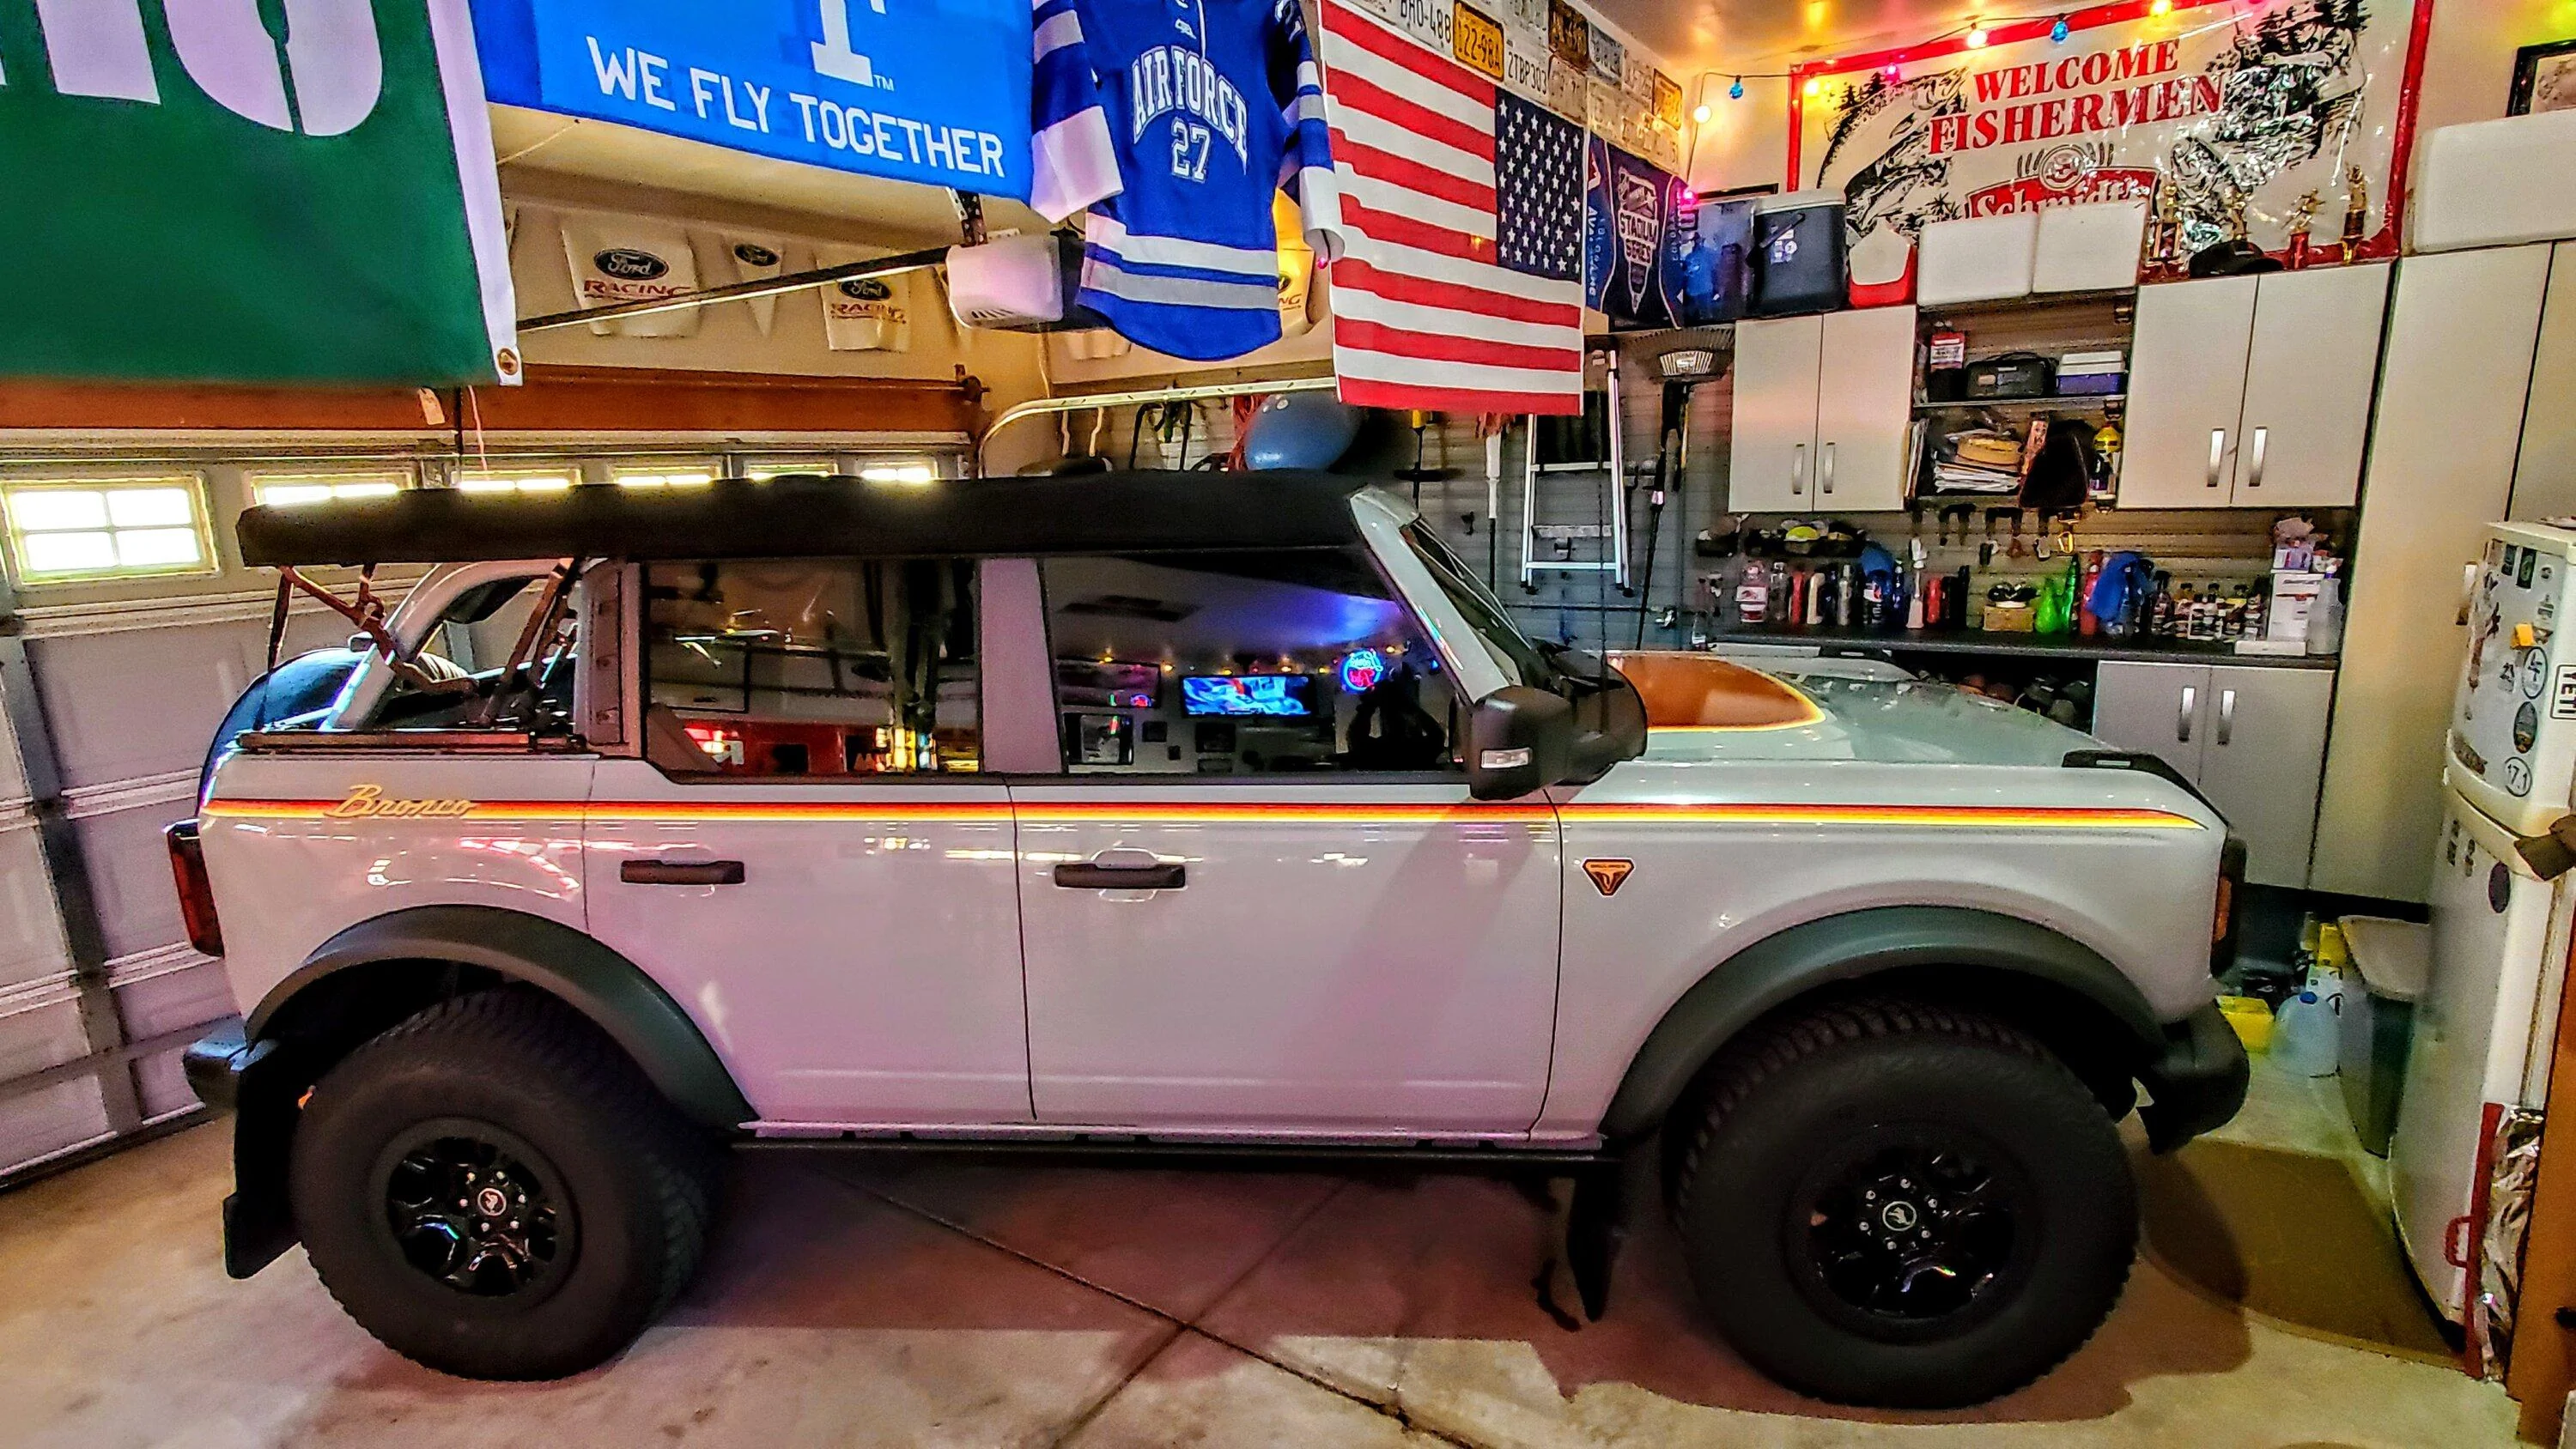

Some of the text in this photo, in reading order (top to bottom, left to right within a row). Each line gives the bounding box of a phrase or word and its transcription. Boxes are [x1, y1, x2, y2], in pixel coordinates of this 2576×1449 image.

[1973, 39, 2180, 103] WELCOME
[586, 36, 1005, 178] WE FLY TOGETHER
[1132, 45, 1248, 176] AIR FORCE
[1928, 74, 2225, 155] FISHERMEN
[1171, 117, 1211, 184] 27
[607, 252, 653, 276] Ford
[324, 784, 478, 818] Bronco
